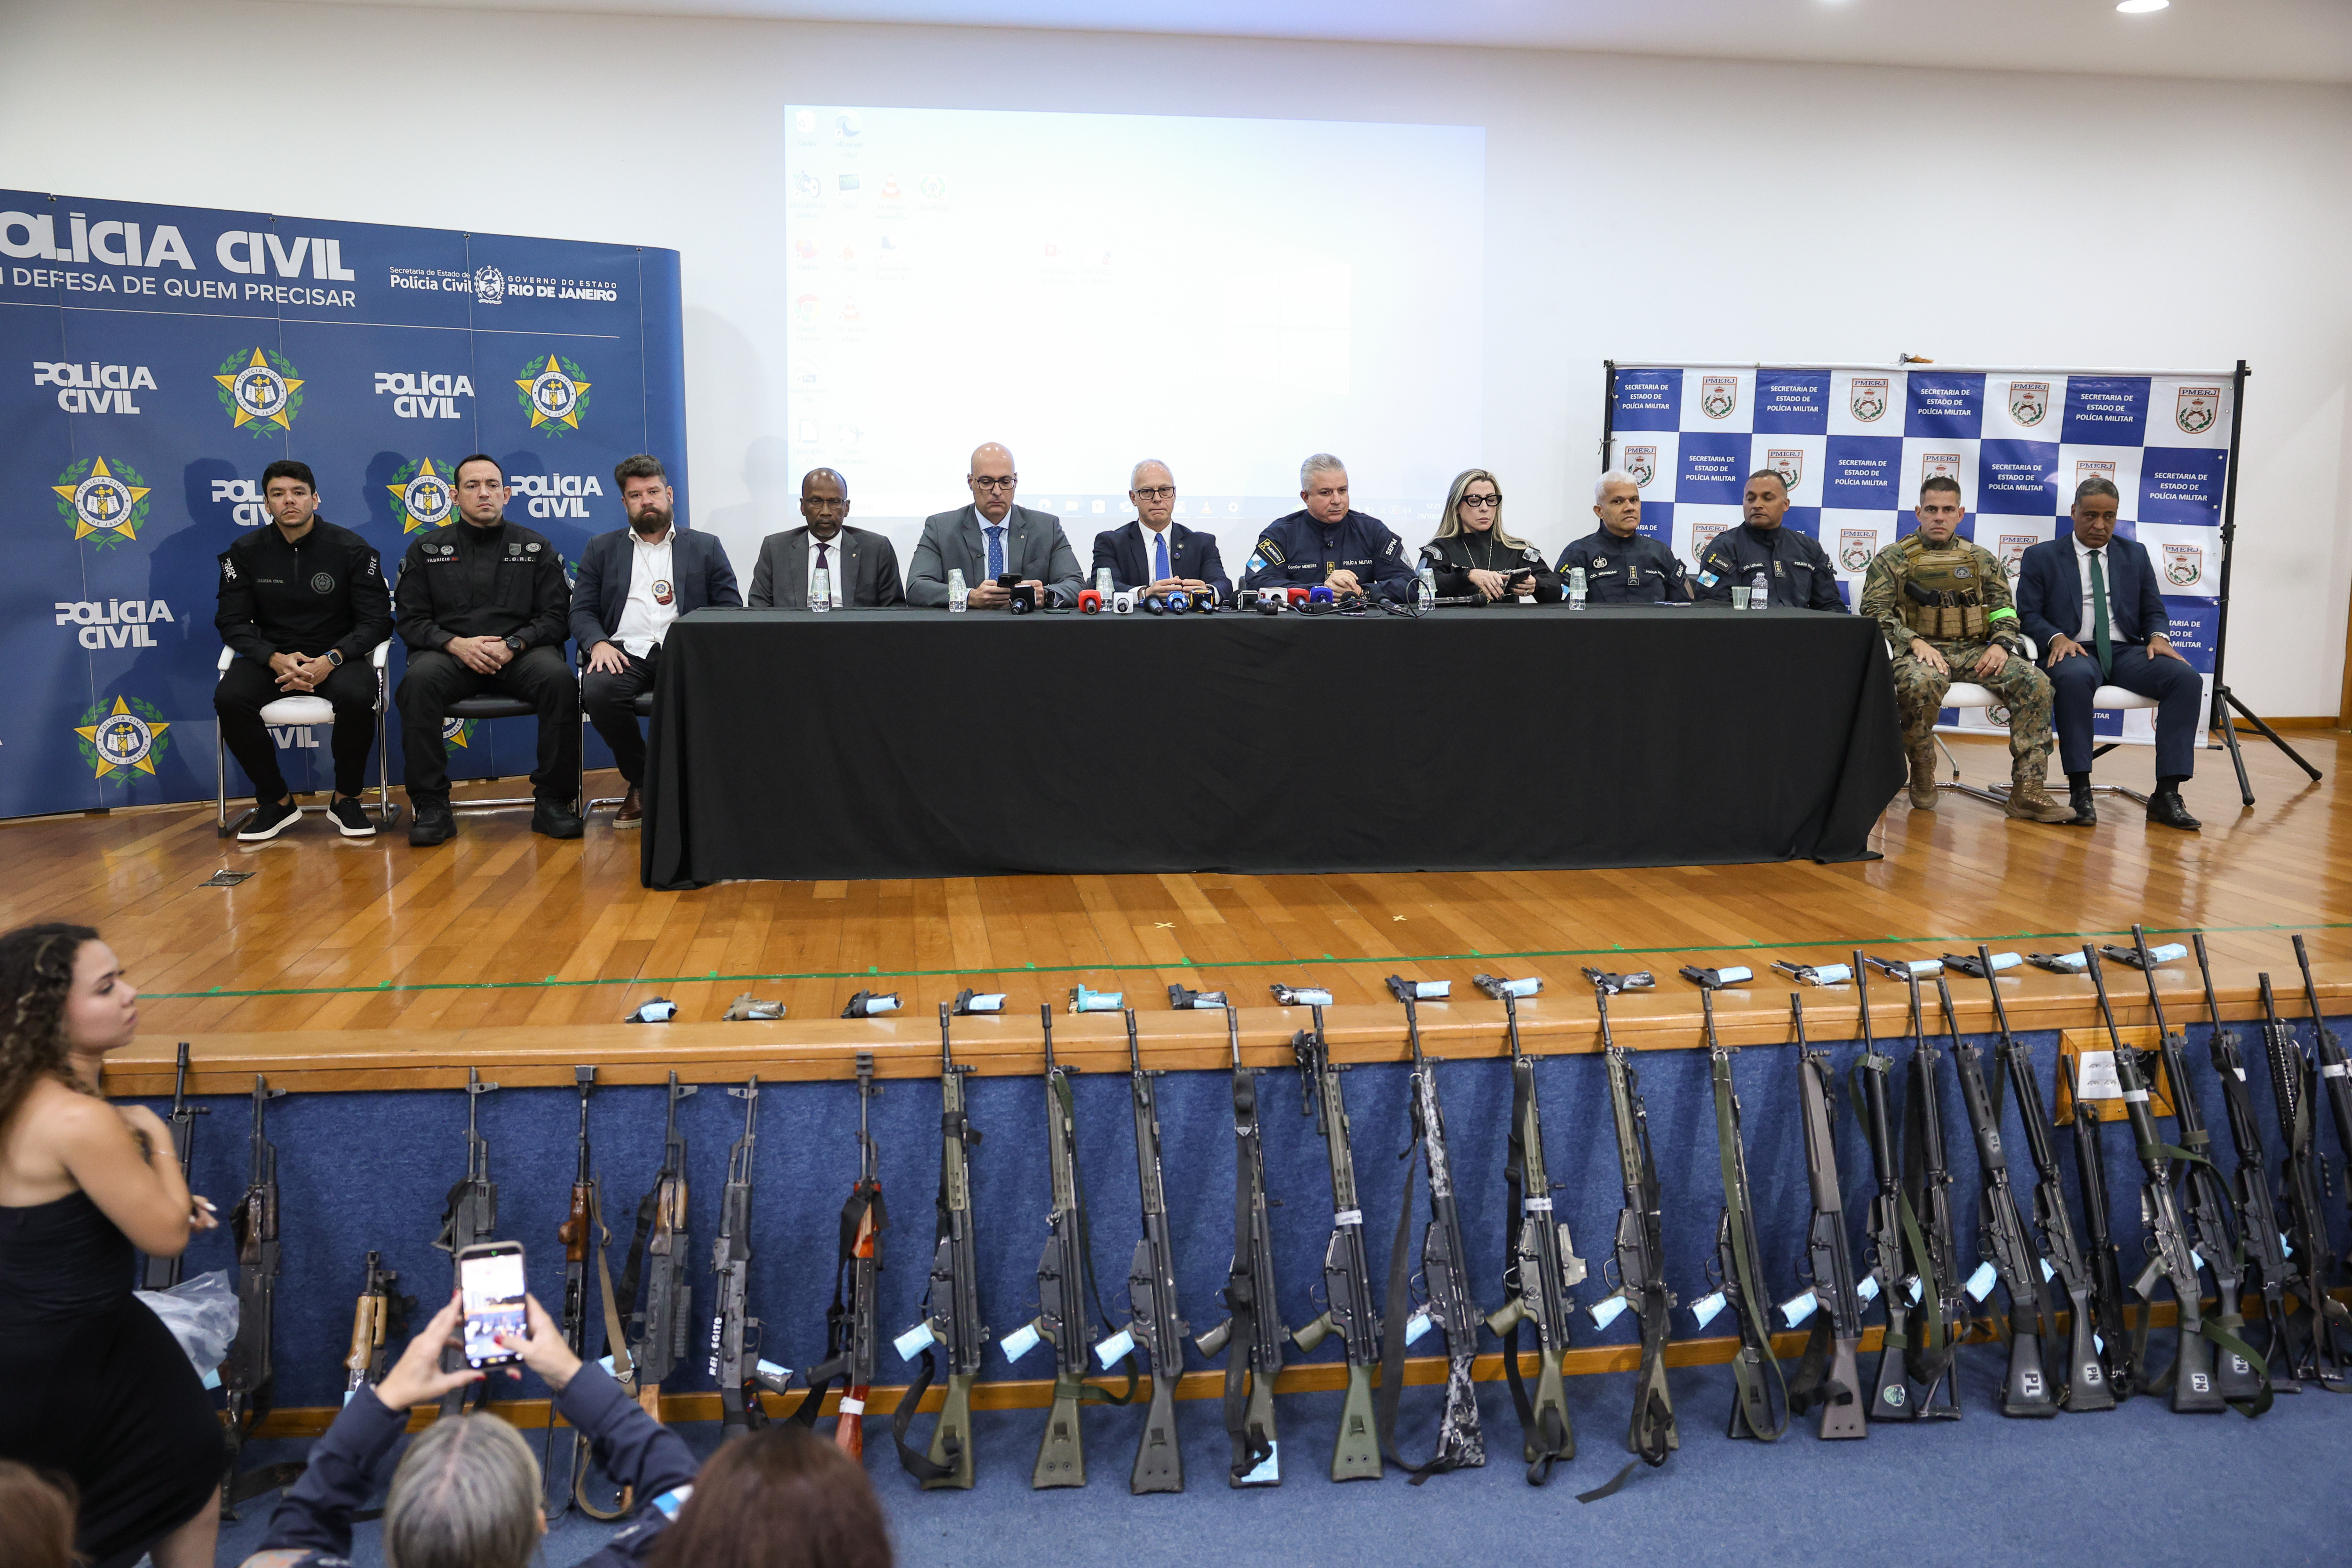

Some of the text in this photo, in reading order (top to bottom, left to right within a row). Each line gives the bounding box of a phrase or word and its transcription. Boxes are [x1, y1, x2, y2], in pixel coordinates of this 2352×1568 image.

[0, 210, 355, 282] OLÍCIA CIVIL
[389, 266, 425, 276] Secretaria
[437, 270, 460, 278] Estado
[13, 268, 356, 308] DEFESA DE QUEM PRECISAR
[389, 274, 473, 294] Polícia Civil
[508, 275, 556, 285] GOVERNO
[579, 280, 617, 289] ESTADO
[508, 284, 617, 302] RIO DE JANEIRO
[238, 368, 282, 384] POLÍCIA CIVIL
[535, 374, 572, 388] POLÍCIA CIVIL
[1854, 379, 1887, 387] PMERJ
[1921, 388, 1960, 397] SECRETARIA
[2013, 382, 2047, 391] PMERJ
[57, 387, 141, 415] CIVIL
[238, 397, 247, 407] RIO
[261, 397, 285, 415] JANEIRO
[393, 395, 461, 419] CIVIL
[554, 400, 574, 416] JANEIRO
[79, 478, 126, 494] POLÍCIA CIVIL
[408, 478, 448, 492] POLÍCIA CIVIL
[2150, 492, 2177, 500] POLÍCIA
[407, 505, 416, 514] RIO
[429, 504, 450, 521] JANEIRO
[528, 495, 590, 518] CIVIL
[79, 509, 88, 519] RIO
[105, 508, 129, 526] JANEIRO
[1843, 529, 1875, 538] PMERJ
[2002, 536, 2035, 544] PMERJ
[1266, 545, 1282, 562] MENEZES
[1385, 537, 1398, 556] SEPM
[367, 555, 377, 576] DRE
[1715, 558, 1729, 568] LUCIANO
[78, 623, 157, 650] CIVIL
[99, 716, 145, 733] POLÍCIA CIVIL
[99, 748, 109, 757] RIO
[125, 744, 148, 763] JANEIRO
[2088, 1366, 2099, 1382] PN
[2023, 1372, 2040, 1396] PL
[2194, 1375, 2207, 1392] PN
